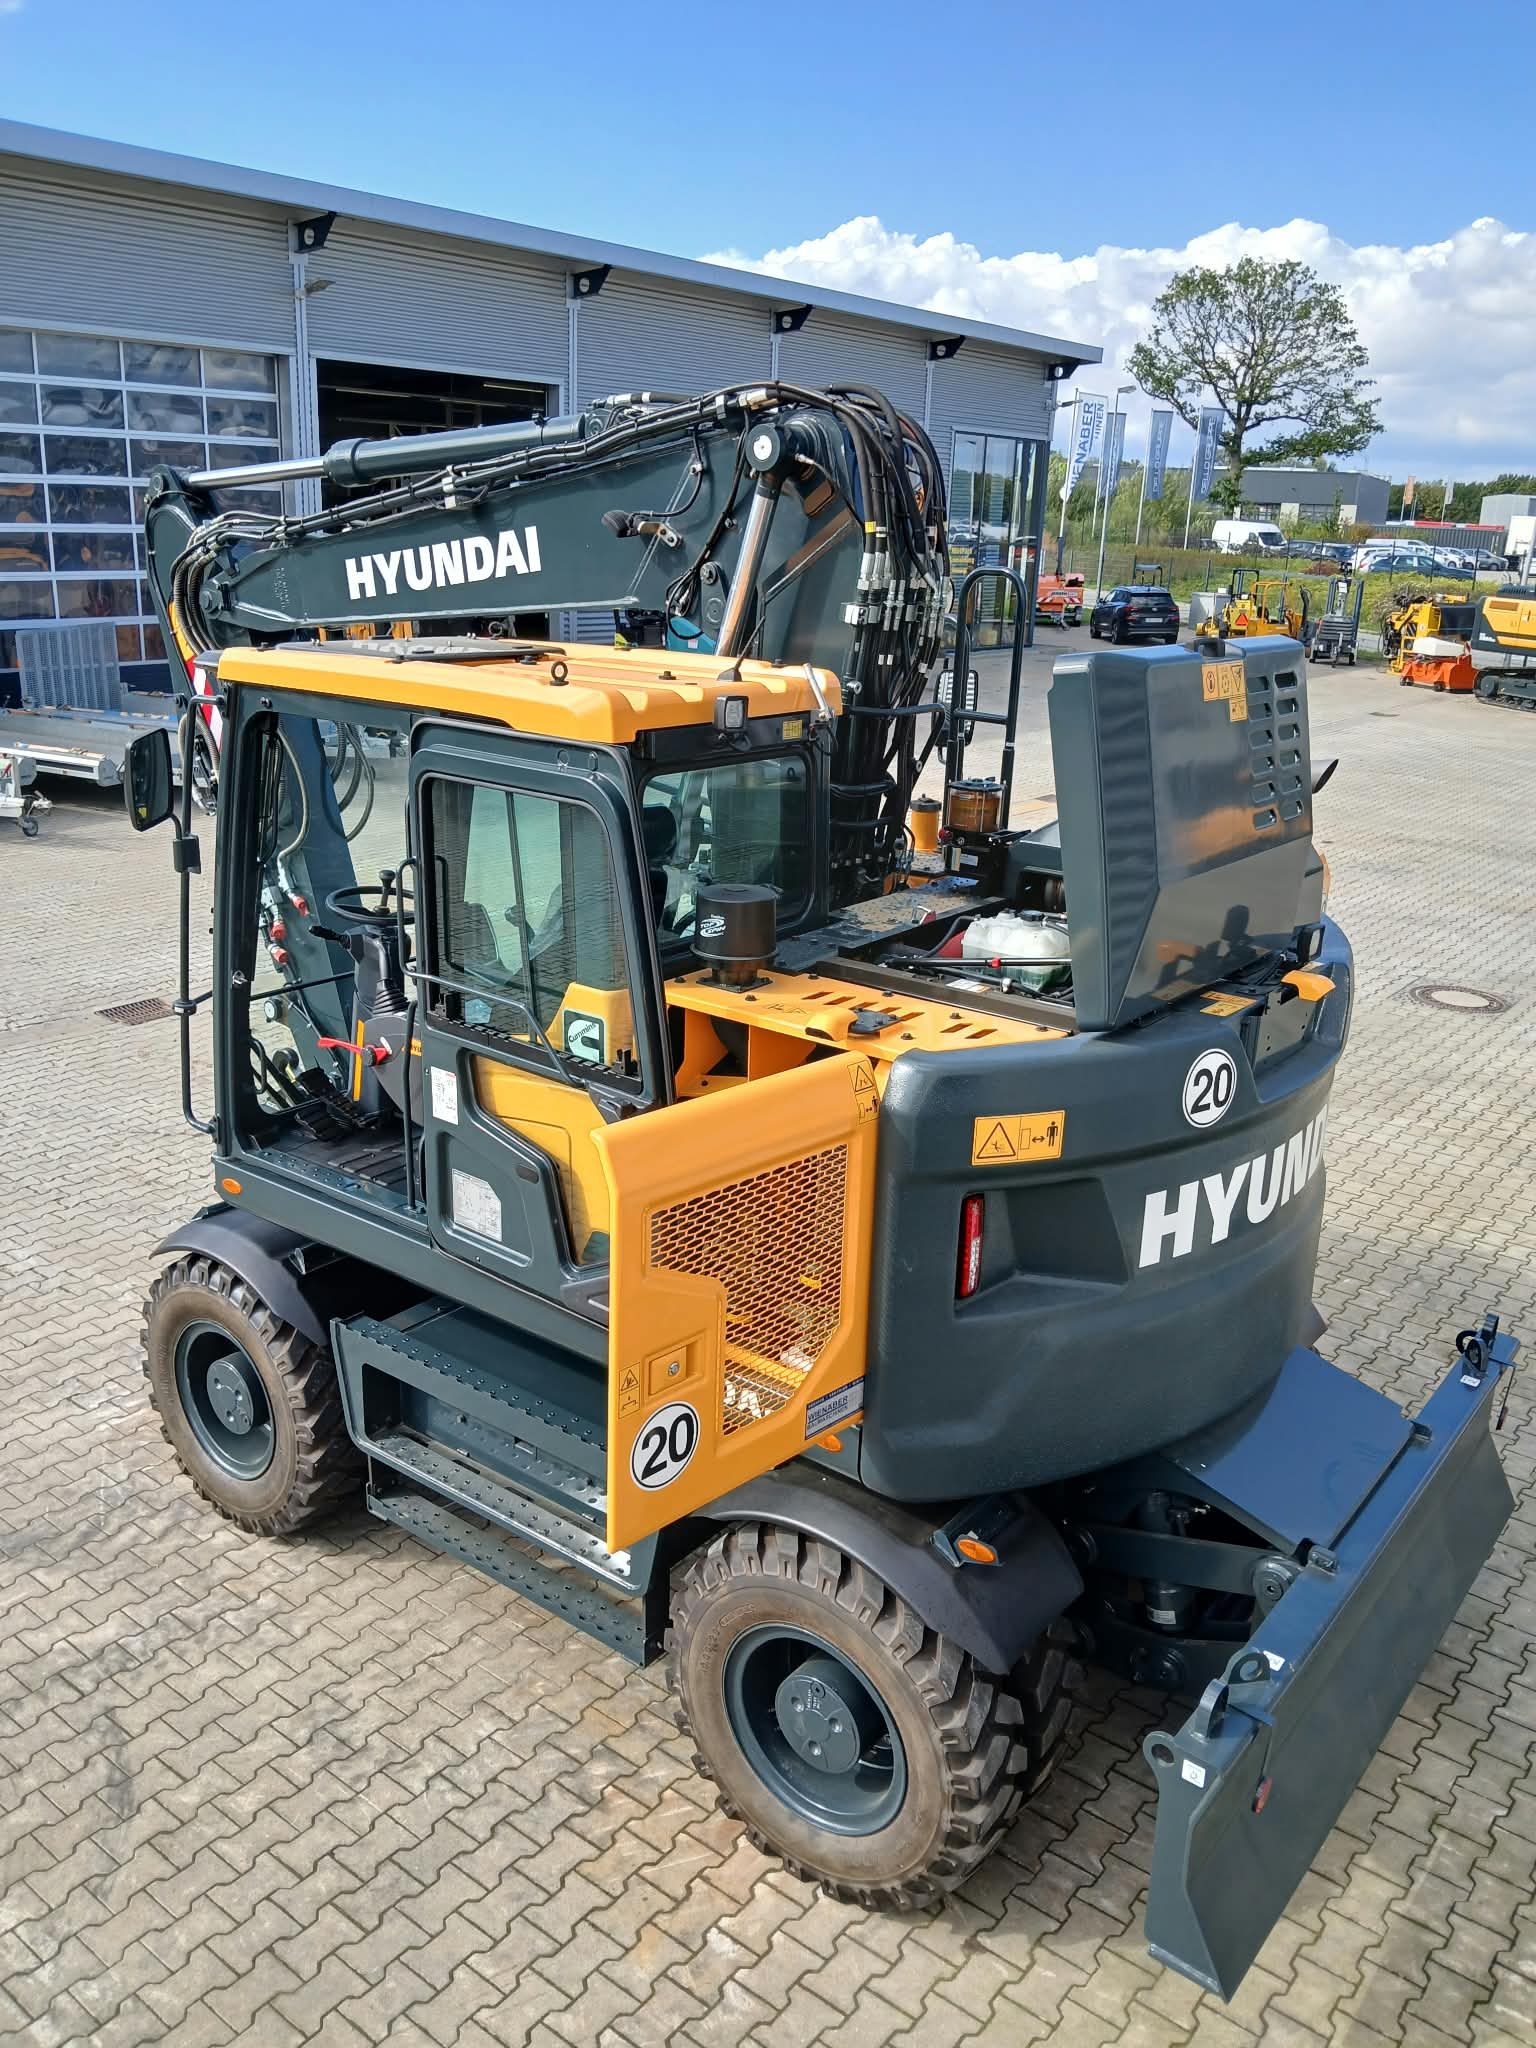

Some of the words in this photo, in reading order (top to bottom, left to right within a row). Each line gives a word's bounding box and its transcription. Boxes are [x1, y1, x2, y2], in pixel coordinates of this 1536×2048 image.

[344, 525, 542, 601] HYUNDAI
[568, 1022, 597, 1042] Cummins
[1190, 1062, 1234, 1115] 20
[641, 1412, 695, 1481] 20
